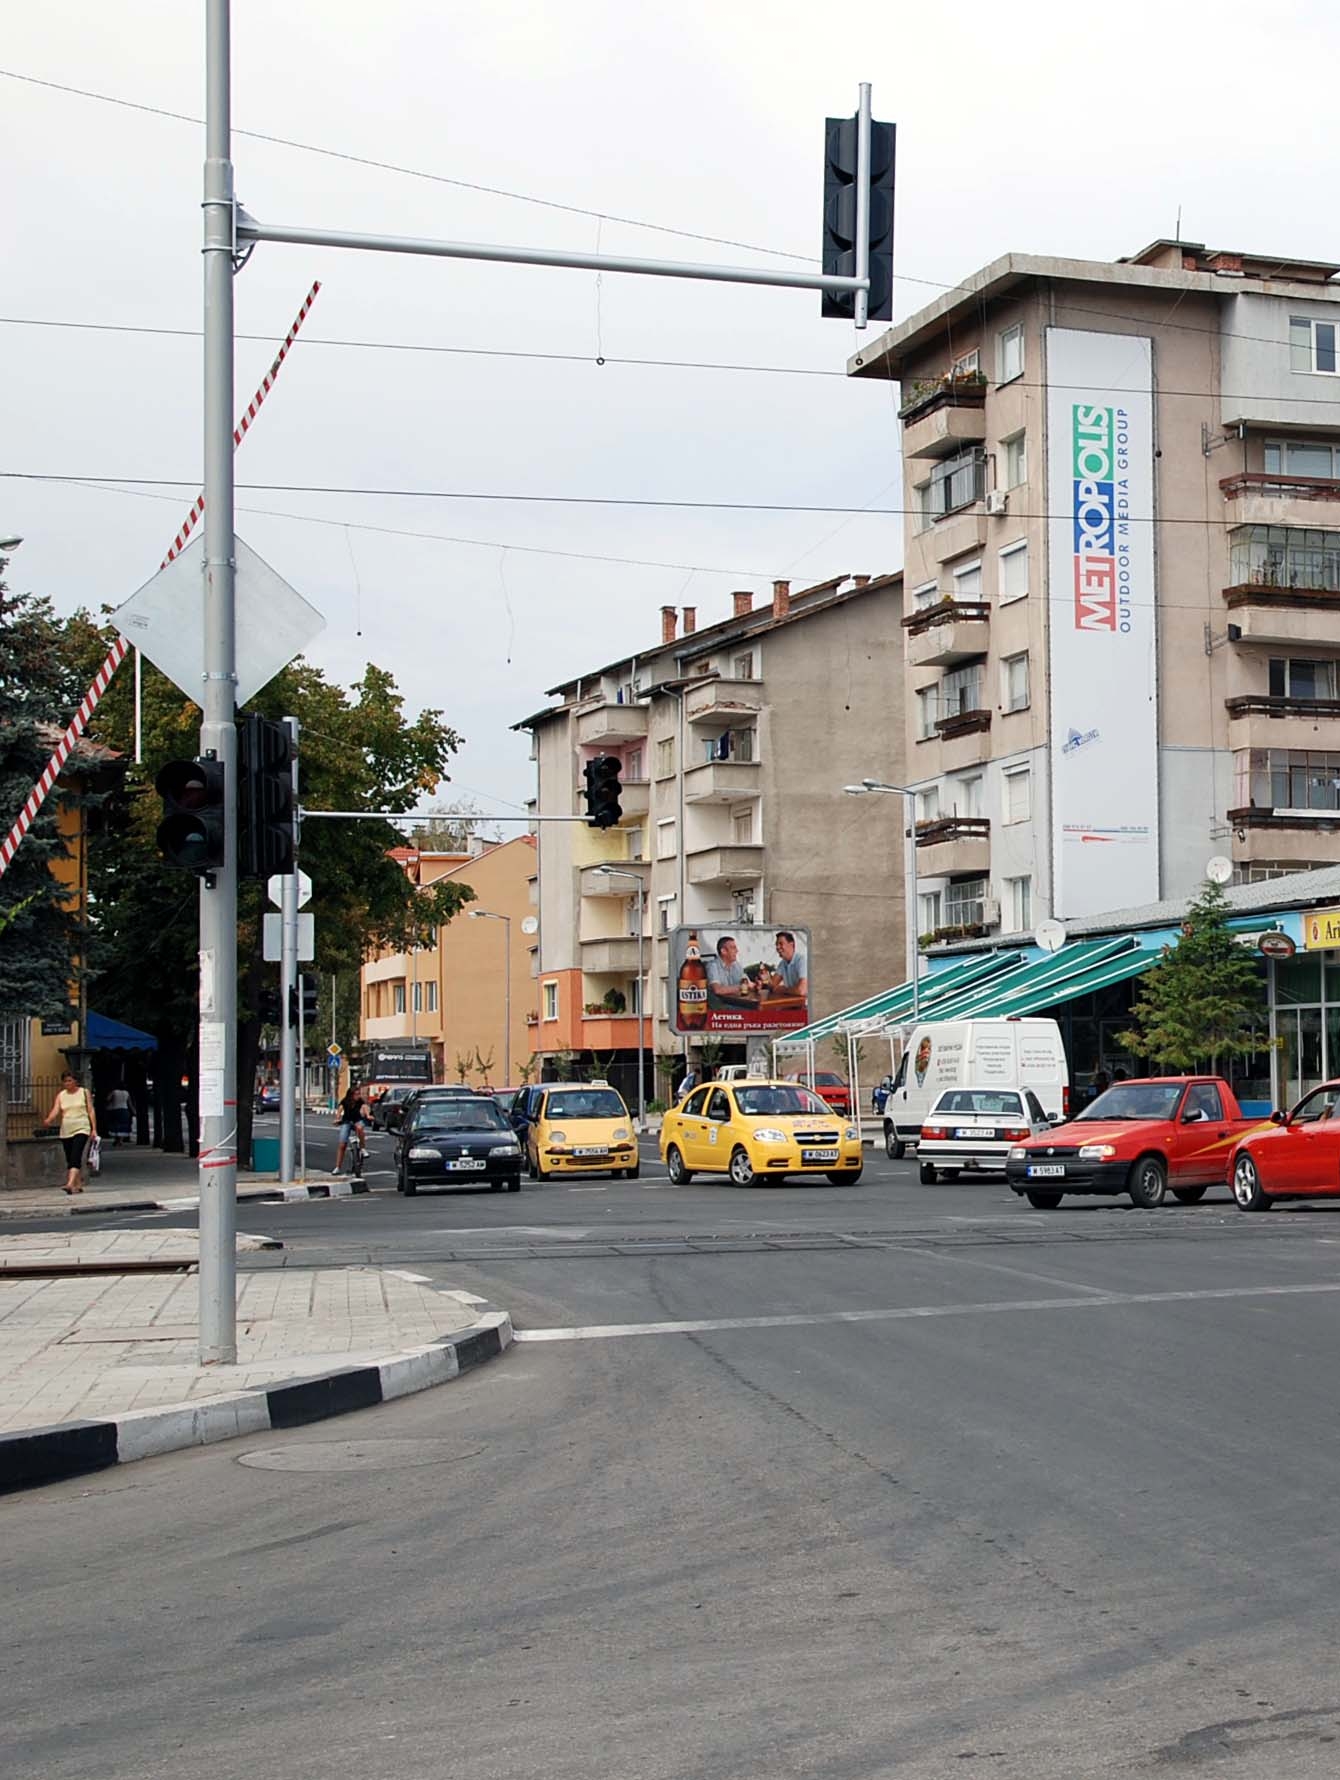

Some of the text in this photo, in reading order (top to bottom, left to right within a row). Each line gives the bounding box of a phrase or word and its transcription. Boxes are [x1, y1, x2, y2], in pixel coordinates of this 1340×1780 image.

[1076, 404, 1113, 631] METROPOLIS
[1117, 408, 1131, 633] OUTDOOR MEDIA GROUP
